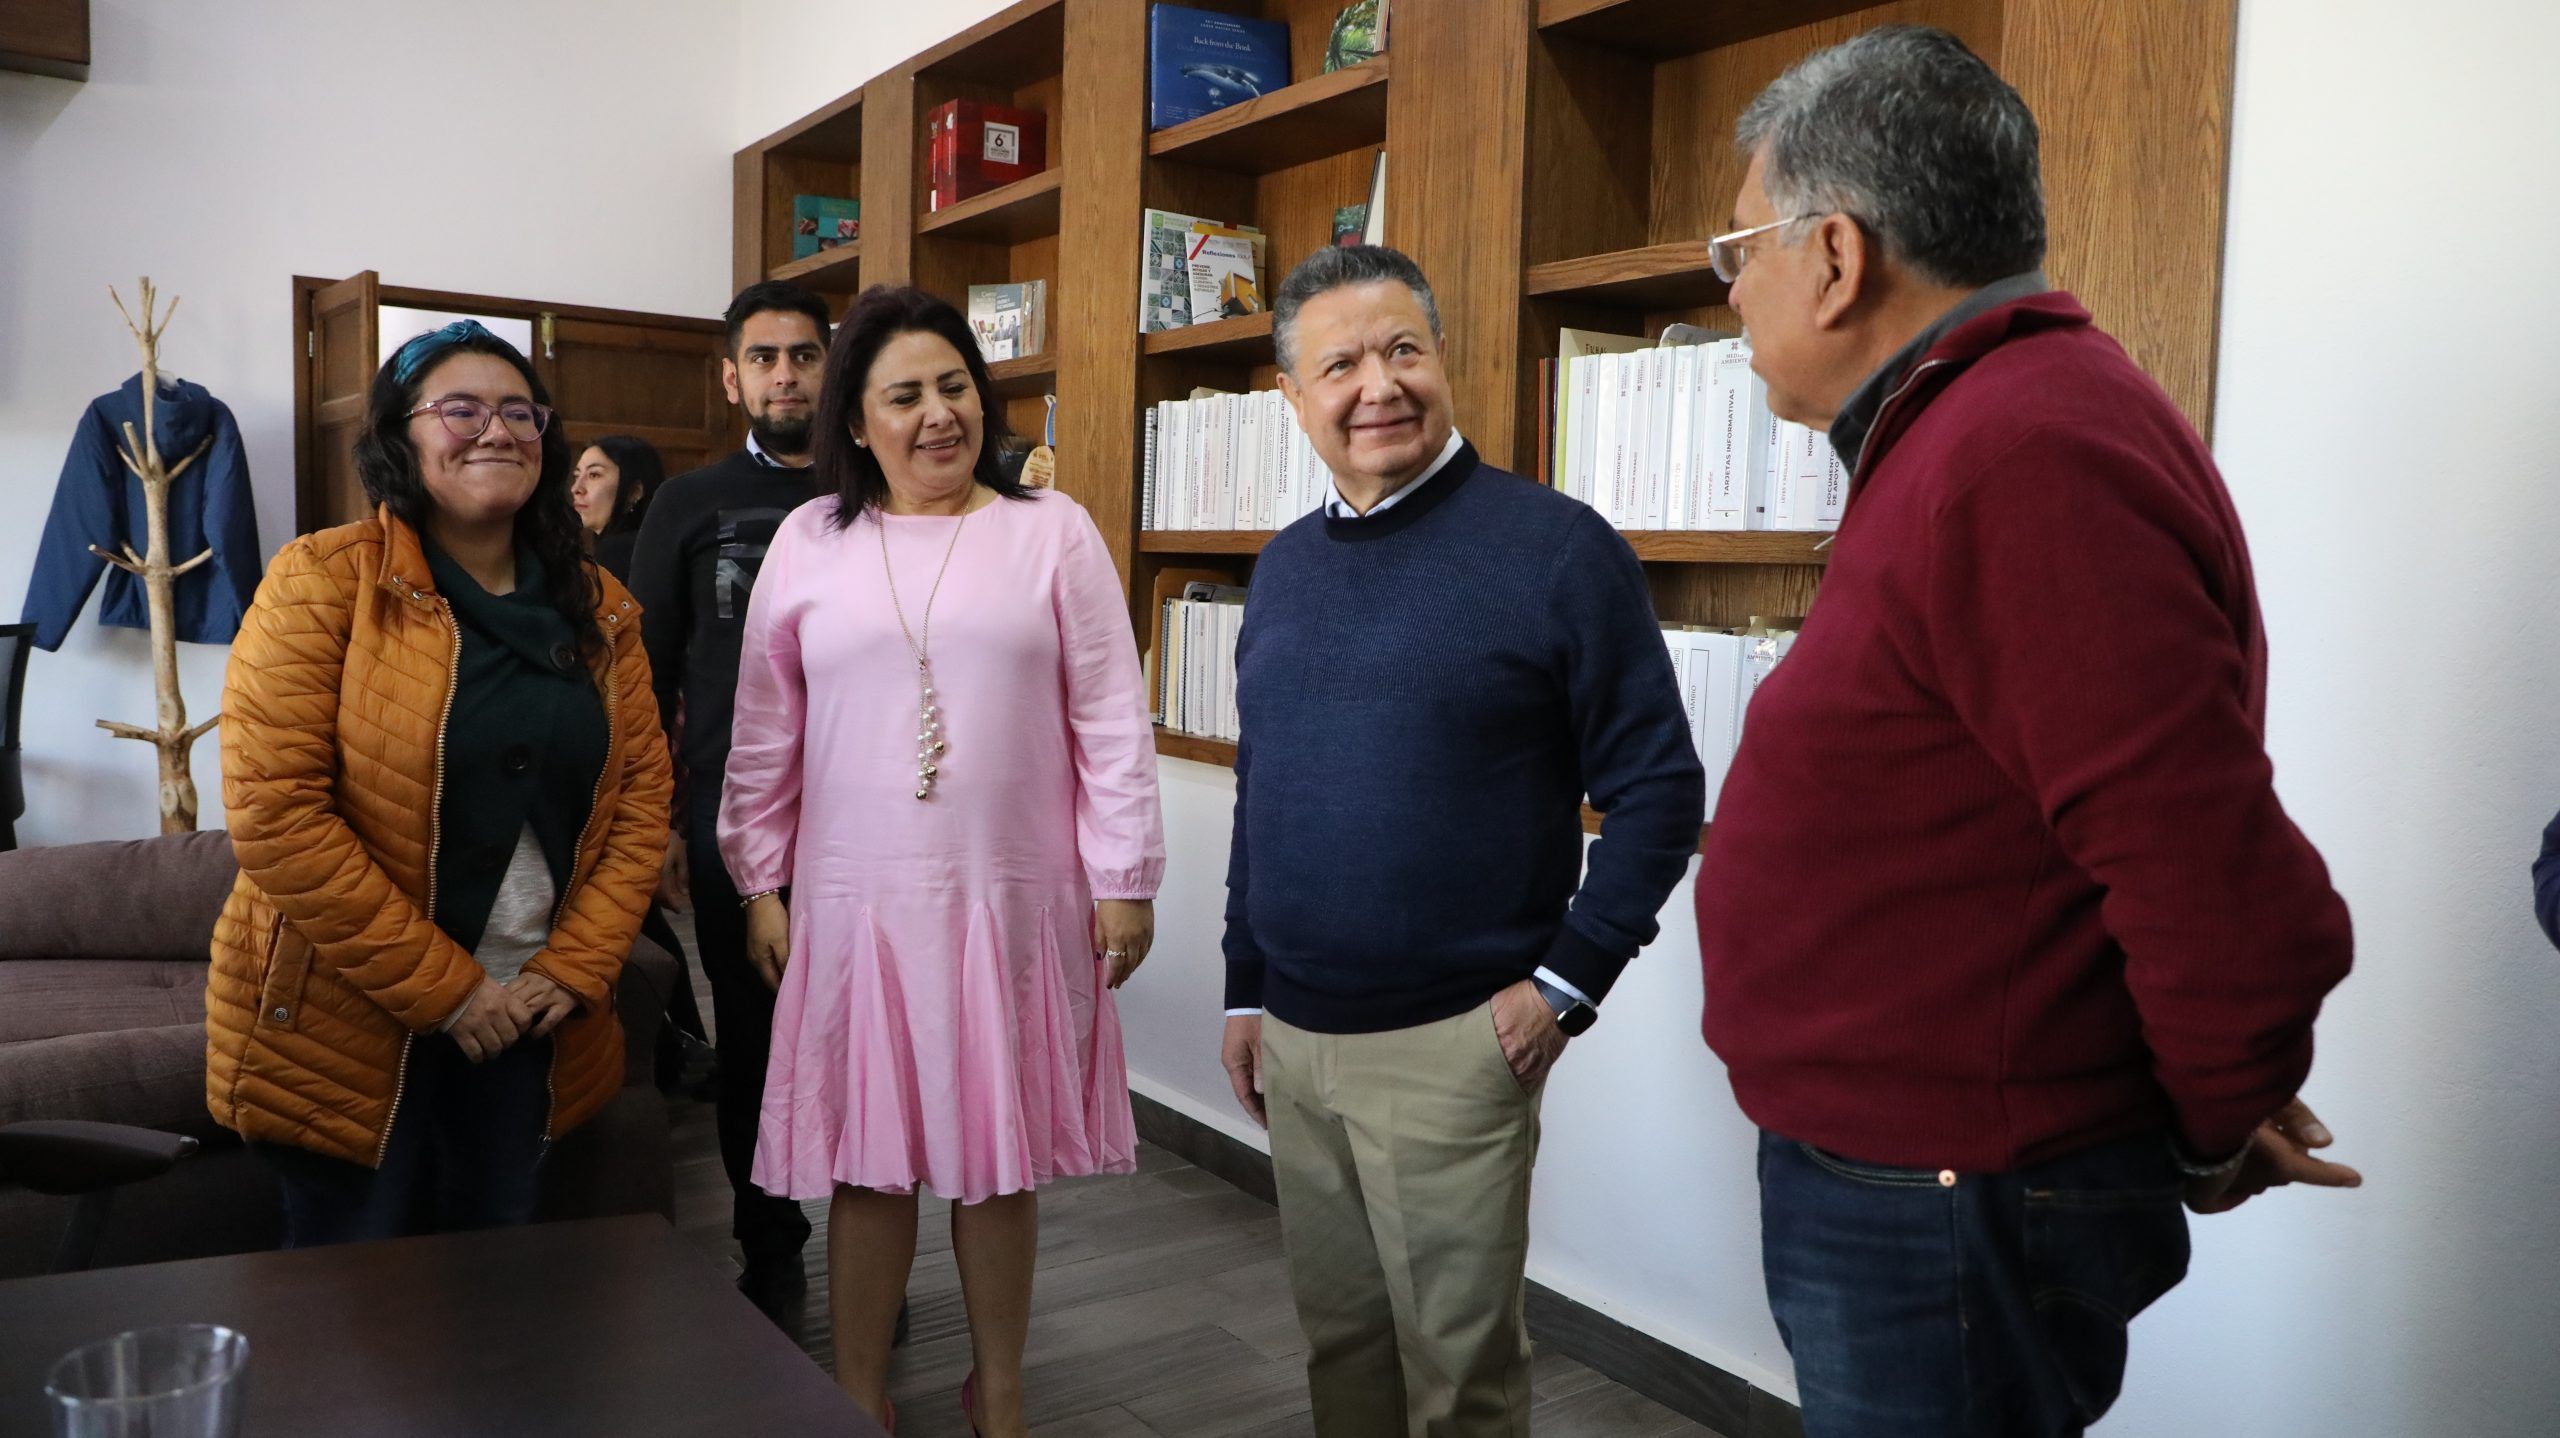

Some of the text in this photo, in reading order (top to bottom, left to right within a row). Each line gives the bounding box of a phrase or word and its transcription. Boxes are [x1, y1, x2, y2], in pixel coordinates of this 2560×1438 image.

[1194, 35, 1208, 44] Back
[1209, 38, 1224, 47] from
[1235, 42, 1252, 51] Brink
[1202, 250, 1236, 258] Reflexiones
[1726, 388, 1734, 452] INFORMATIVAS
[1832, 494, 1837, 506] DE
